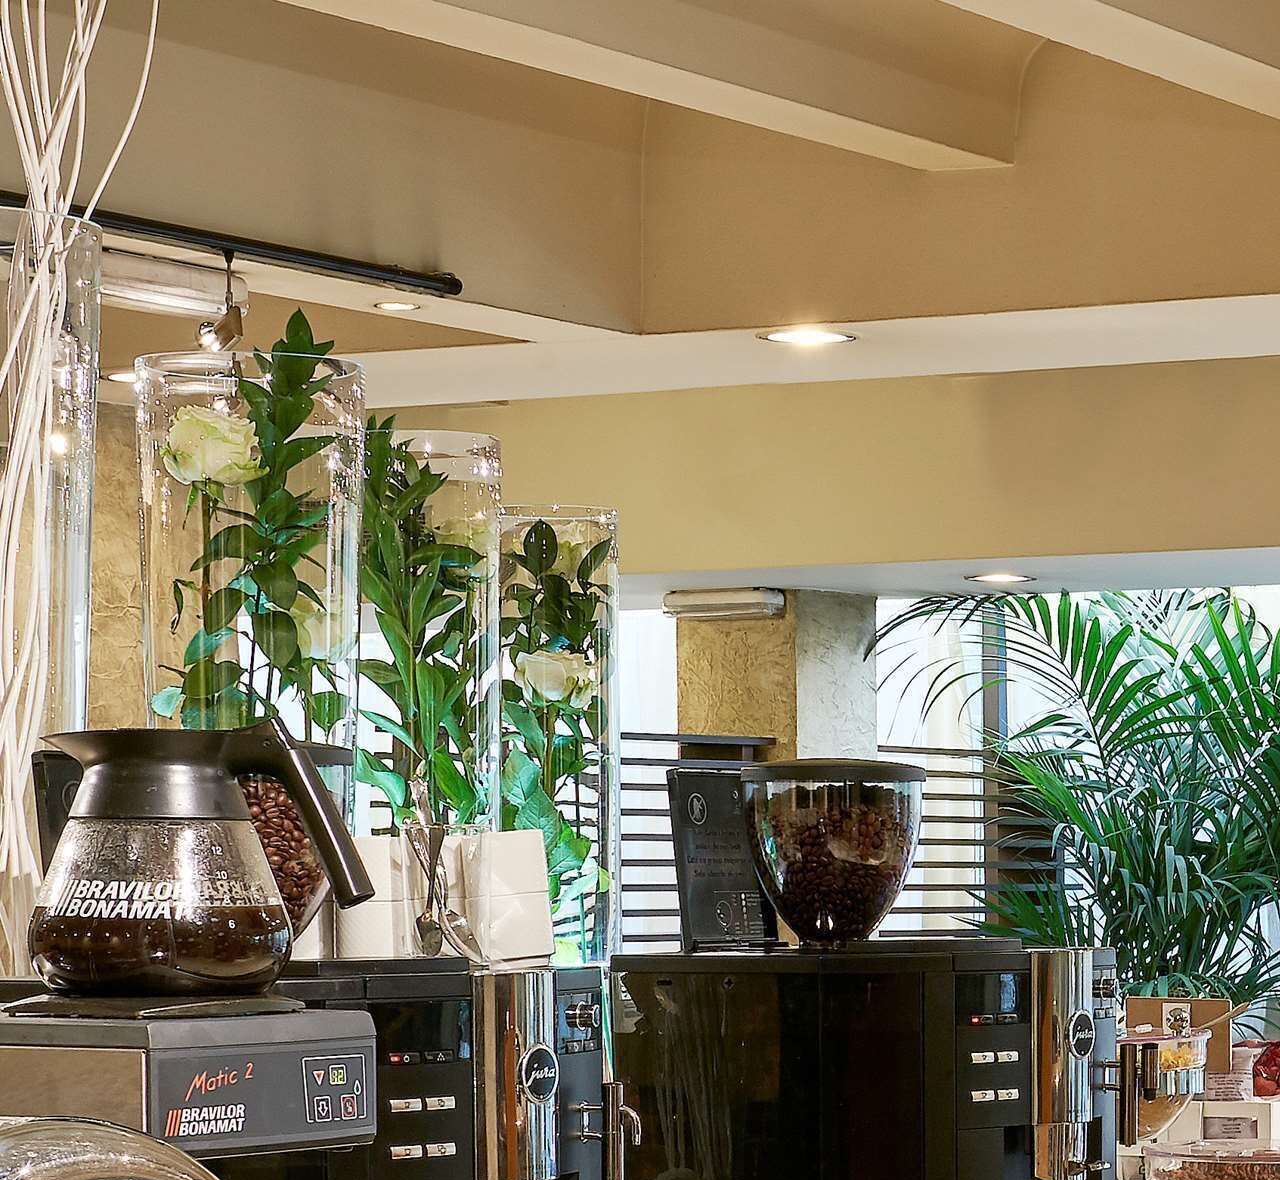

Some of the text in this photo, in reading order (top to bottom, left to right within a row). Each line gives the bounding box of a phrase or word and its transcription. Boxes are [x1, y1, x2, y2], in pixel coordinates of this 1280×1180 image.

[211, 846, 223, 855] 12
[216, 870, 228, 880] 10
[228, 919, 236, 929] 6
[185, 1062, 254, 1101] Matic 2
[525, 1063, 556, 1087] jura
[180, 1103, 246, 1123] BRAVILOR
[178, 1117, 246, 1137] BONAMAT
